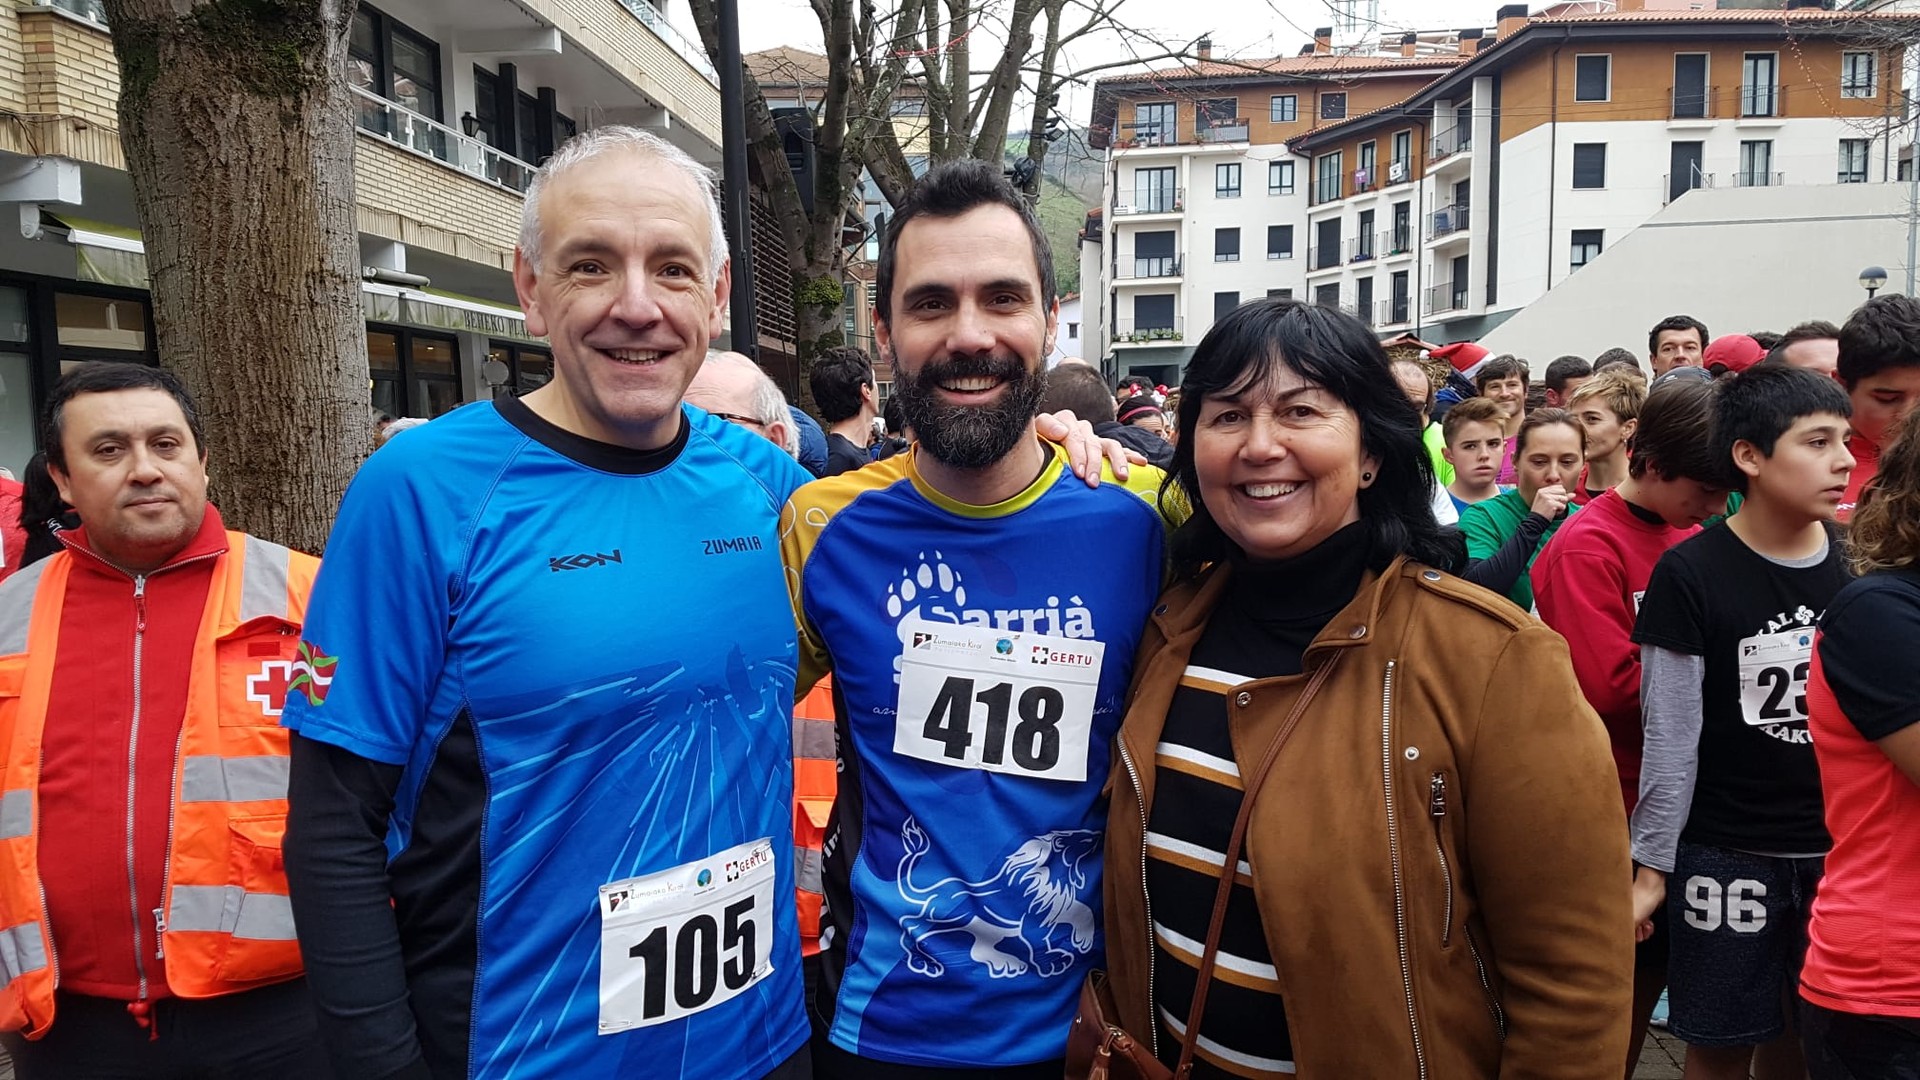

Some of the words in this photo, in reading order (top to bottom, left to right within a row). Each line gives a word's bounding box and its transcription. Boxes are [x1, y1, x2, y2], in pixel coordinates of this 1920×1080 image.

[701, 536, 762, 555] ZUMAIA
[1050, 651, 1093, 666] GERTU
[922, 675, 1064, 772] 418
[739, 851, 768, 872] GERTU
[1684, 875, 1767, 933] 96
[629, 894, 756, 1020] 105
